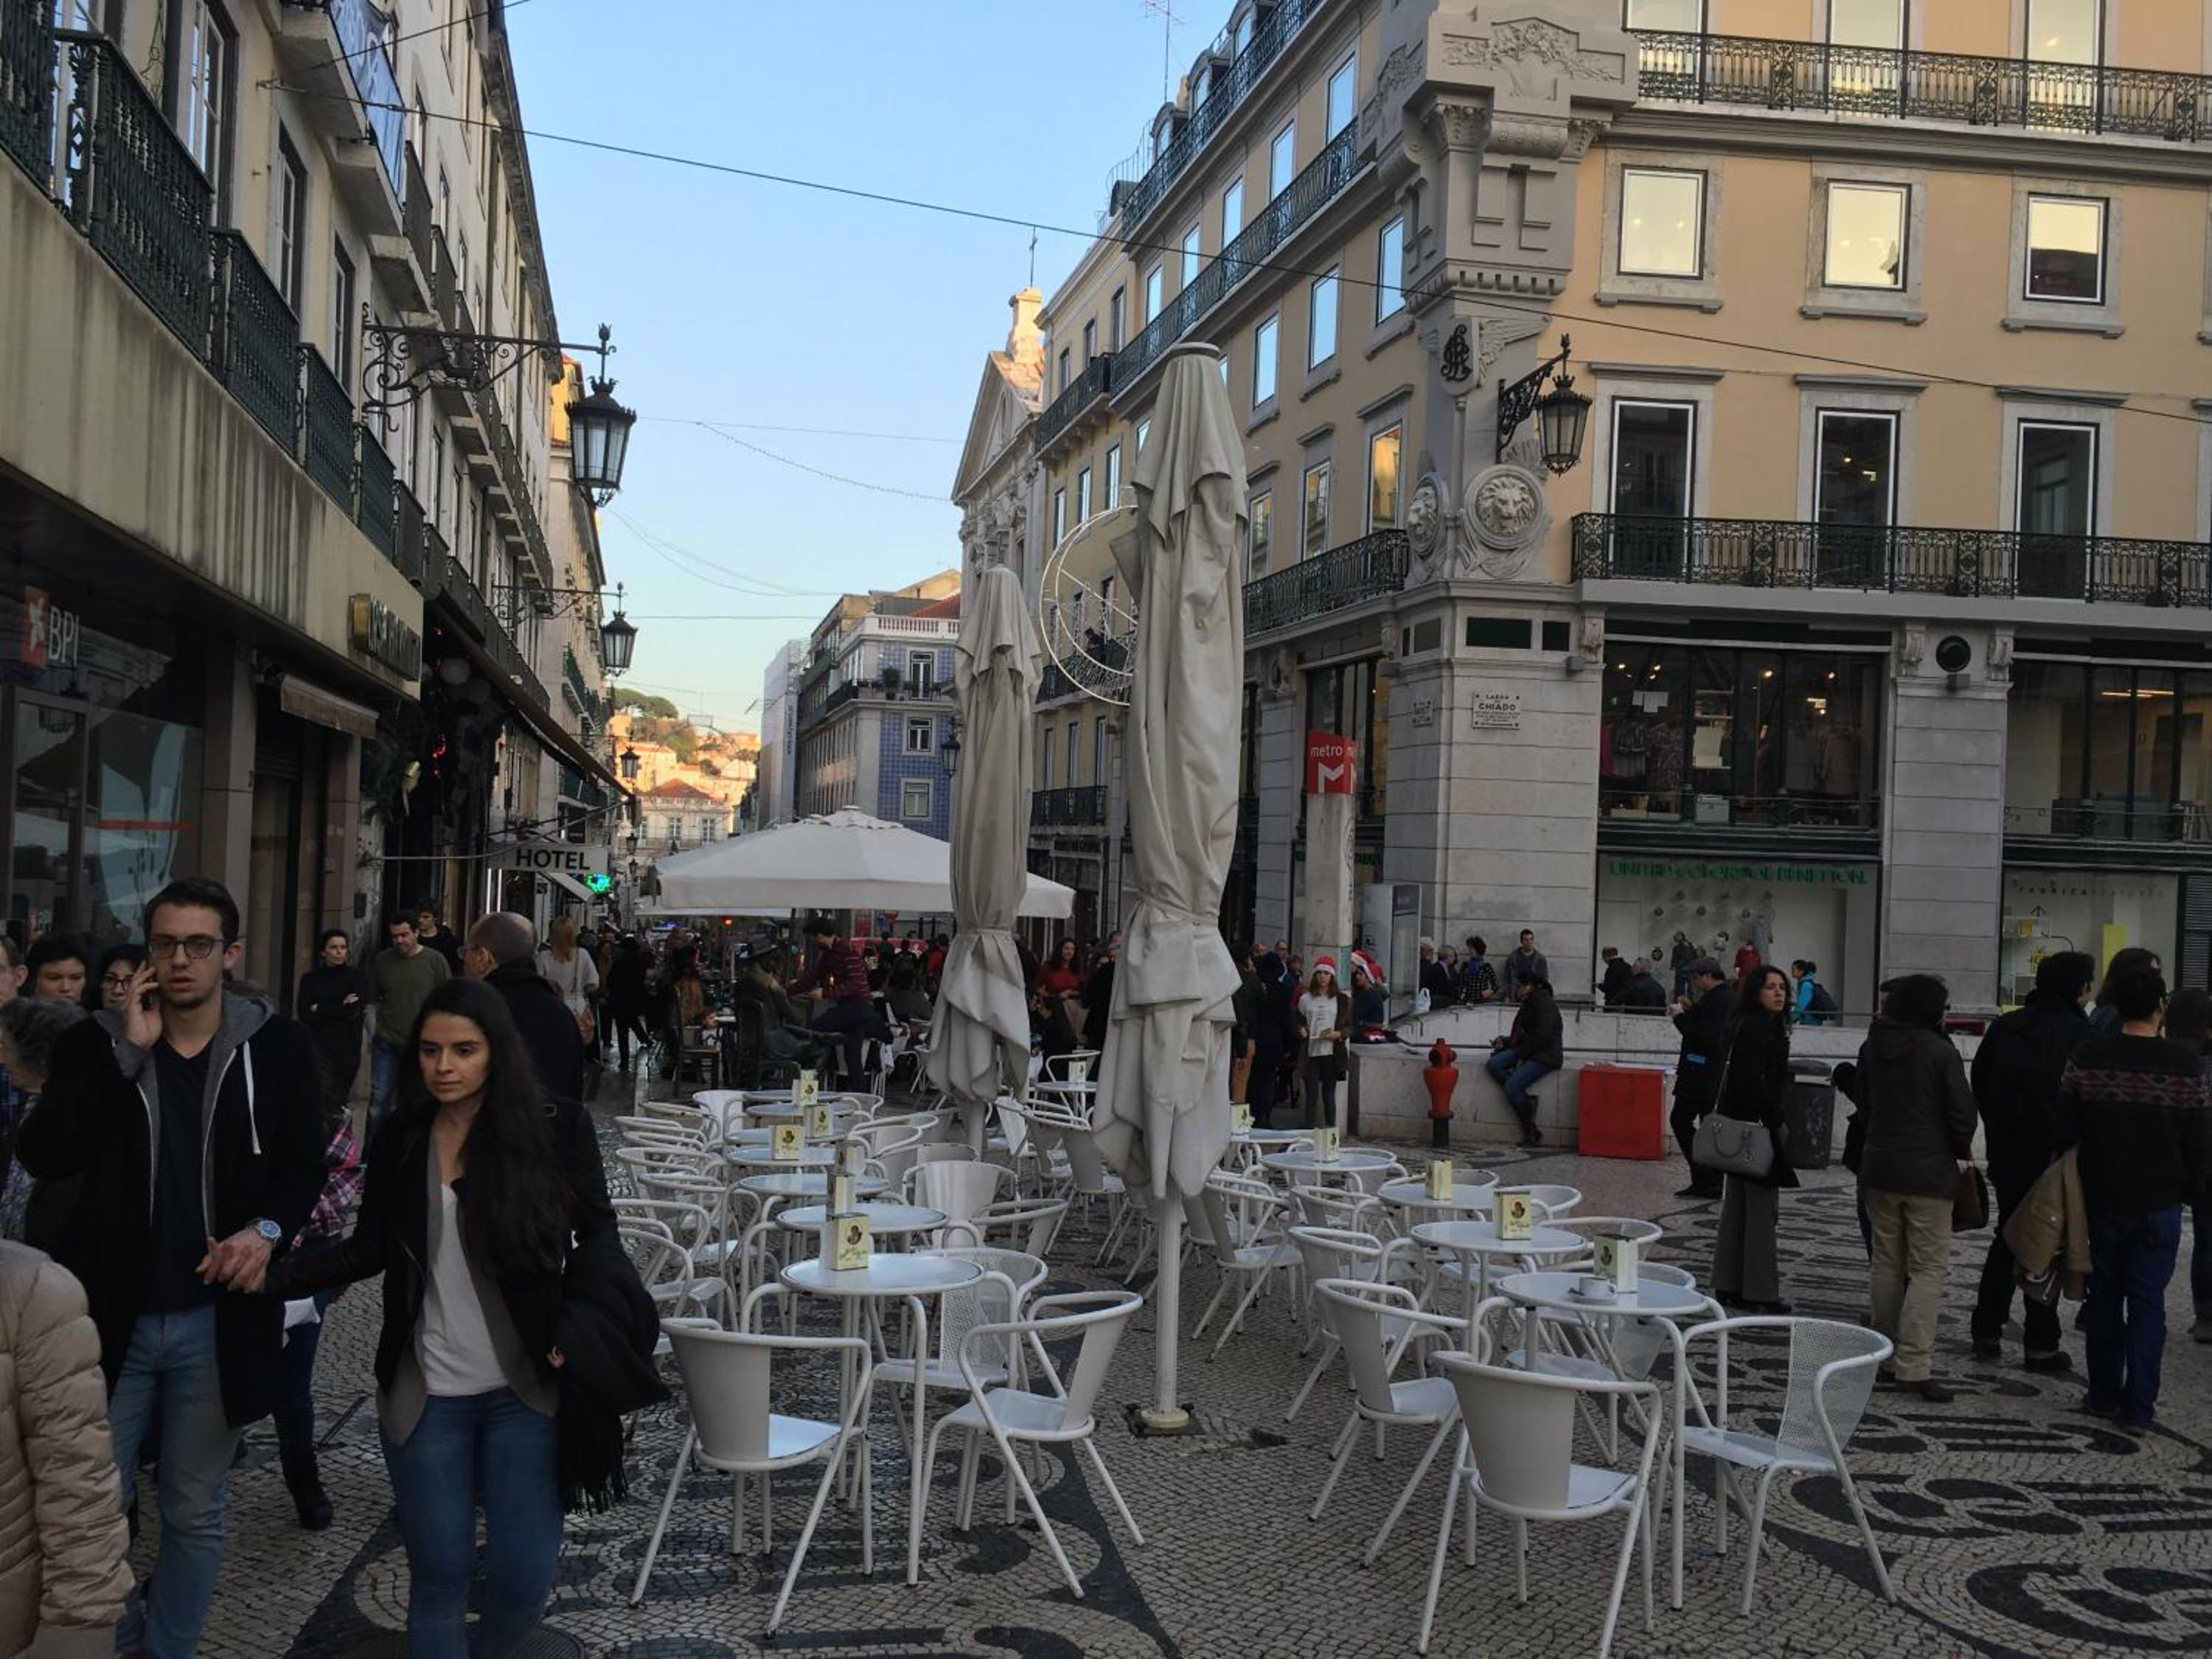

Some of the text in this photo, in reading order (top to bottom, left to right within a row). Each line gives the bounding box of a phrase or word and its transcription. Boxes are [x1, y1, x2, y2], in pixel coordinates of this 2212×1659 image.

[47, 605, 80, 667] BPI
[1478, 703, 1517, 712] CHIADO
[1310, 743, 1343, 757] metro
[516, 849, 591, 870] HOTEL
